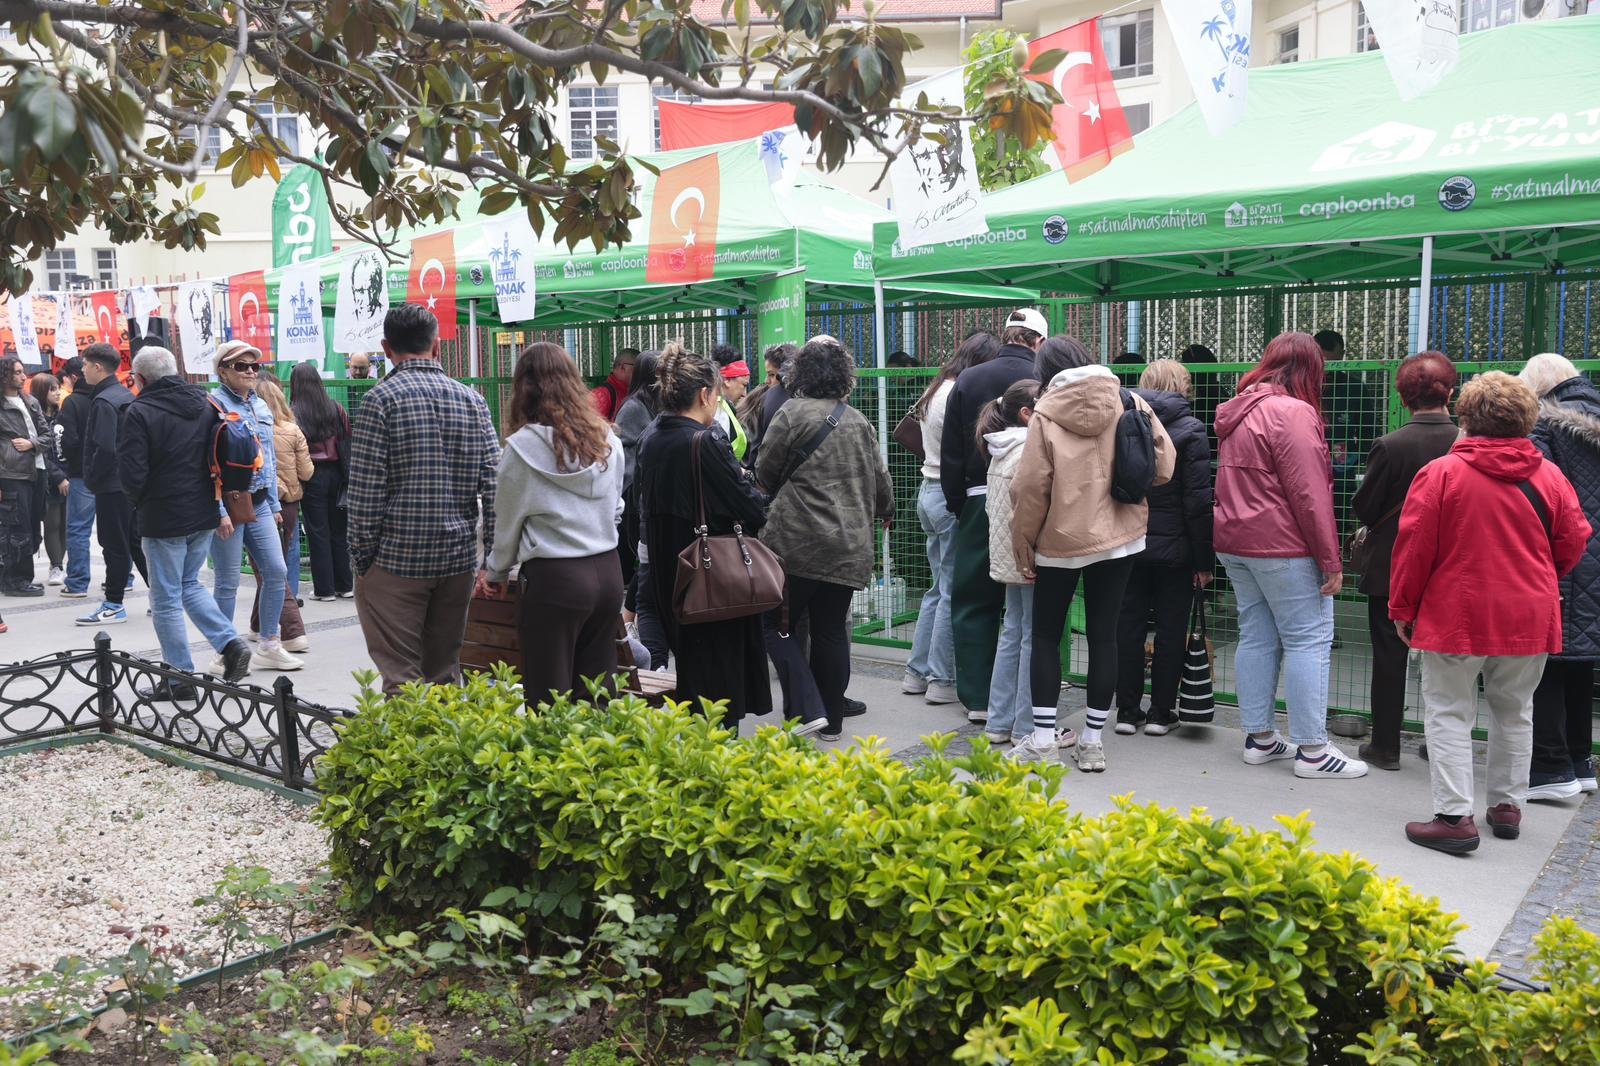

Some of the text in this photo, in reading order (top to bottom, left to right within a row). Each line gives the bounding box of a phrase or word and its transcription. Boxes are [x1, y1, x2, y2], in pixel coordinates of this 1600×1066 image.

[1300, 192, 1416, 219] caploonba
[601, 253, 659, 273] caploonba
[286, 325, 320, 338] KONAK
